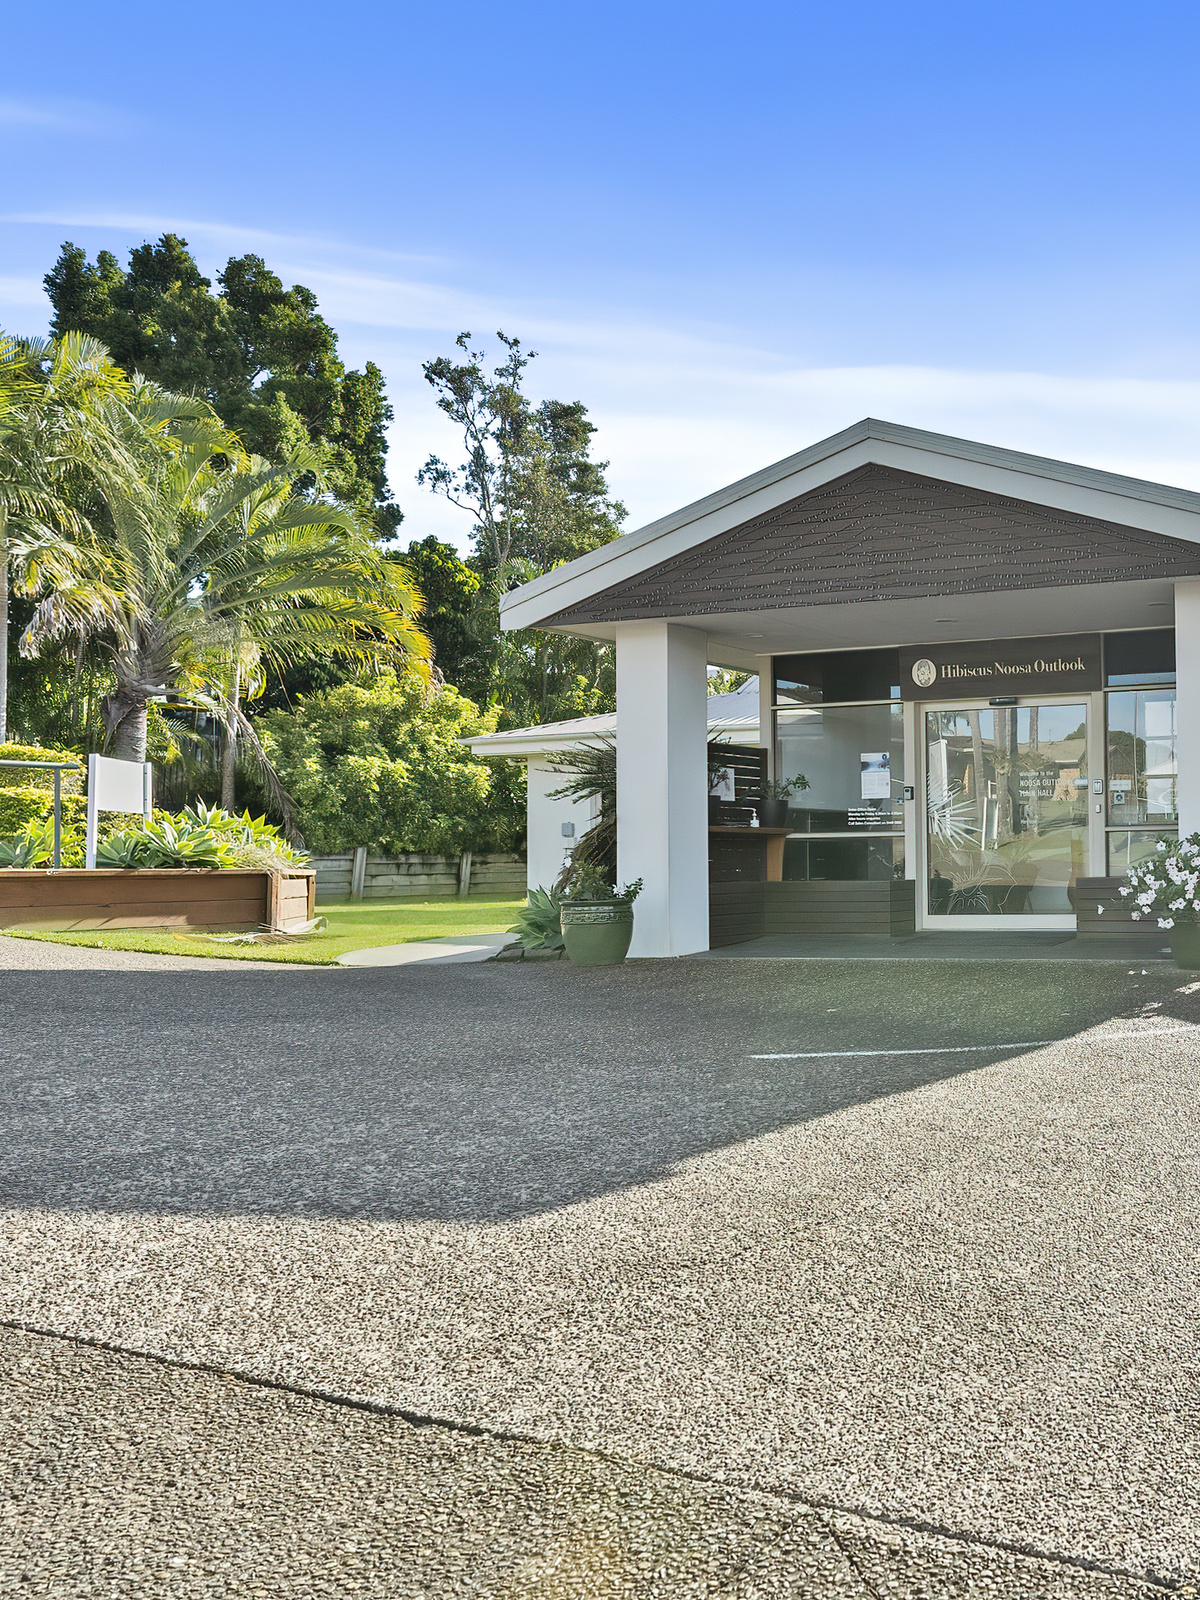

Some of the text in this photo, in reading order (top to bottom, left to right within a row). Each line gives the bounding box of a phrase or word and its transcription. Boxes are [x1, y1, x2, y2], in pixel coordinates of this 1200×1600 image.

[941, 657, 1086, 678] Hibiscus Noosa Outlook
[1019, 779, 1041, 787] NOOSA
[1037, 789, 1053, 797] HALL
